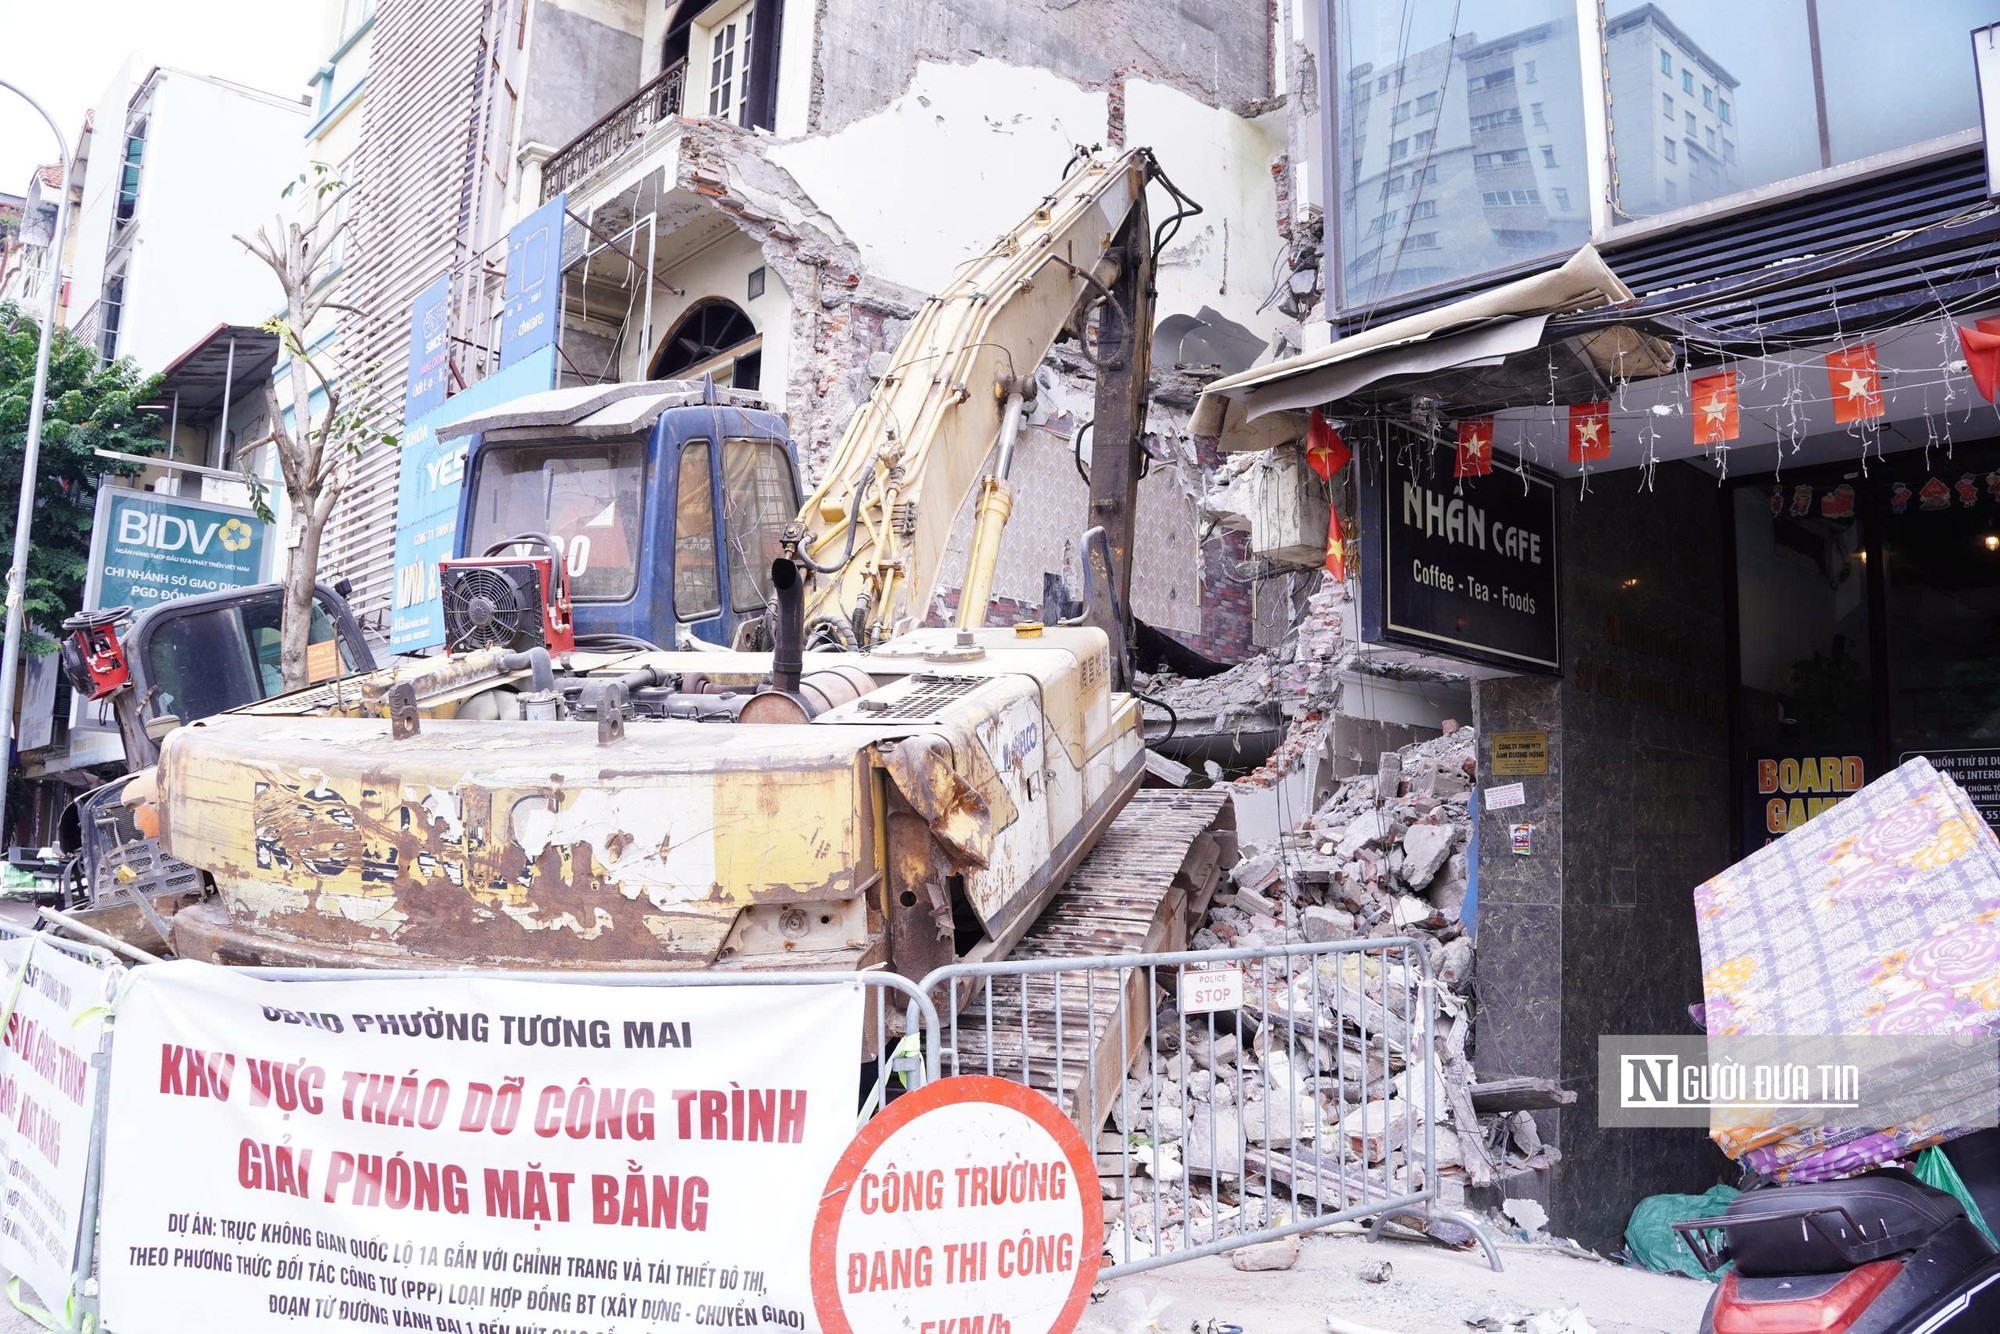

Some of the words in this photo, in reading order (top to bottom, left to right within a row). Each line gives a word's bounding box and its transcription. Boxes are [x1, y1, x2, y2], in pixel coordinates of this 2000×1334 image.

[119, 509, 220, 555] BIDV
[1403, 481, 1486, 551] NHÂN
[1492, 521, 1542, 565] CAFE
[104, 566, 125, 577] CHI
[126, 568, 169, 584] NHÁNH
[171, 574, 188, 586] SỞ
[189, 577, 217, 590] GIAO
[131, 586, 158, 598] PGD
[1412, 559, 1455, 592] Coffee
[1467, 576, 1489, 602] Tea
[1502, 586, 1536, 615] Foods
[1757, 755, 1864, 794] BOARD
[1195, 987, 1231, 1003] STOP
[1199, 974, 1227, 984] POLICE
[353, 1006, 489, 1043] PHƯỜNG
[500, 1014, 612, 1049] TƯƠNG
[623, 1020, 692, 1048] MAI
[160, 1043, 236, 1102] KHU
[246, 1056, 326, 1121] VỰC
[341, 1068, 450, 1131] THÁO
[459, 1075, 525, 1136] DỠ
[534, 1077, 655, 1141] CÔNG
[671, 1081, 808, 1144] TRÌNH
[238, 1133, 313, 1199] GIẢI
[324, 1151, 470, 1215] PHÓNG
[483, 1161, 576, 1232] MẶT
[591, 1159, 710, 1232] BẰNG
[860, 1162, 944, 1216] CÔNG
[954, 1152, 1067, 1208] TRƯỜNG
[168, 1213, 190, 1238] DỰ
[191, 1211, 217, 1236] ÁN:
[220, 1219, 257, 1245] TRỤC
[261, 1221, 312, 1247] KHÔNG
[316, 1230, 347, 1254] GIAN
[350, 1234, 389, 1263] QUỐC
[393, 1240, 414, 1269] LỘ
[419, 1246, 439, 1267] 1A
[443, 1240, 478, 1270] GẮN
[482, 1246, 508, 1271] VỚI
[512, 1246, 562, 1277] CHỈNH
[567, 1256, 618, 1281] TRANG
[623, 1257, 642, 1282] VÀ
[648, 1259, 671, 1285] TÁI
[676, 1260, 717, 1289] THIẾT
[719, 1264, 739, 1291] ĐÔ
[743, 1270, 768, 1297] THỊ,
[847, 1245, 933, 1294] ĐANG
[943, 1241, 988, 1285] THI
[998, 1228, 1074, 1279] CÔNG
[129, 1246, 169, 1267] THEO
[173, 1248, 232, 1273] PHƯƠNG
[236, 1253, 272, 1279] THỨC
[276, 1254, 304, 1281] ĐỐI
[308, 1259, 336, 1285] TÁC
[340, 1265, 376, 1292] CÔNG
[378, 1275, 398, 1297] TƯ
[401, 1279, 443, 1306] (PPP)
[449, 1283, 486, 1311] LOẠI
[489, 1285, 523, 1313] HỢP
[527, 1284, 572, 1314] ĐỒNG
[576, 1293, 597, 1315] BT
[601, 1292, 638, 1319] (XÂY
[641, 1297, 682, 1325] DỰNG
[695, 1299, 758, 1328] CHUYỂN
[762, 1304, 805, 1331] GIAO)
[269, 1294, 311, 1321] ĐOẠN
[315, 1295, 337, 1320] TỪ
[338, 1299, 389, 1326] ĐƯỜNG
[392, 1304, 433, 1332] VÀNH
[436, 1316, 463, 1334] ĐAI
